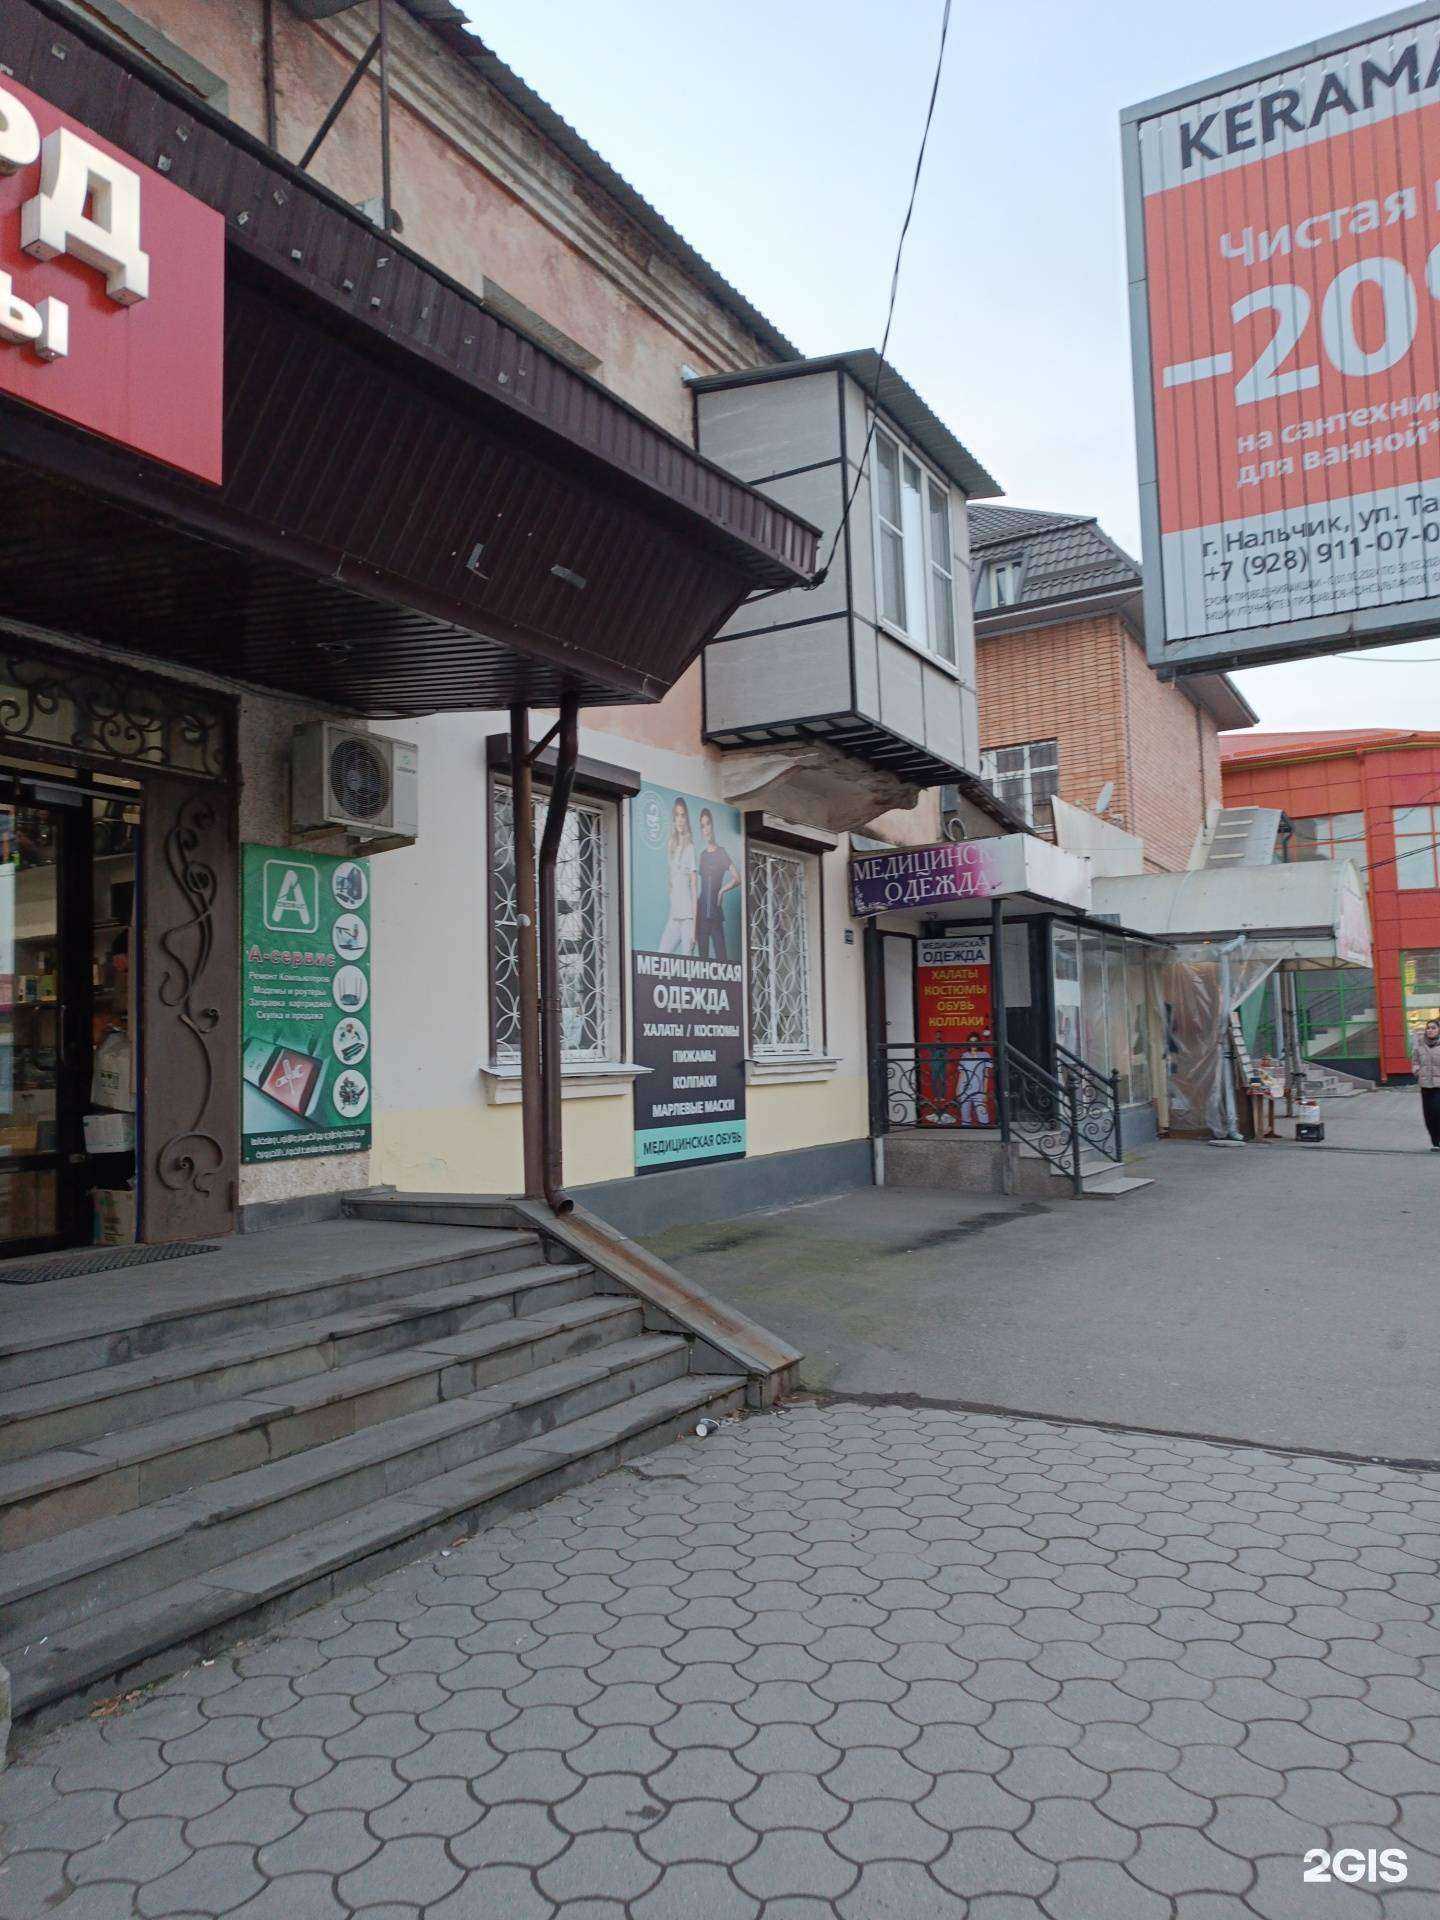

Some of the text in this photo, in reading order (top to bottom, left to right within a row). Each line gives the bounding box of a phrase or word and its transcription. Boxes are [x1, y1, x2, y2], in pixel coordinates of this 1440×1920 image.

[1220, 186, 1417, 266] Чистая
[1237, 431, 1273, 455] на
[1236, 463, 1294, 488] для
[1202, 541, 1218, 558] г.
[1226, 513, 1350, 553] Нальчик,
[1358, 505, 1399, 532] ул.
[1204, 561, 1233, 582] +7
[1243, 549, 1307, 583] (928)
[884, 869, 991, 903] ОДЕЖДА
[923, 949, 985, 963] ОДЕЖДА
[637, 954, 741, 983] МЕДИЦИНСКАЯ
[931, 968, 979, 980] ХАЛАТЫ
[653, 984, 730, 1014] ОДЕЖДА
[924, 985, 987, 996] КОСТЮМЫ
[936, 1000, 975, 1012] ОБУВЬ
[643, 1023, 684, 1037] ХАЛАТЫ
[694, 1025, 740, 1037] КОСТЮМЫ
[928, 1016, 984, 1028] КОЛПАКИ
[672, 1049, 717, 1063] ПИЖАМЫ
[672, 1075, 717, 1089] КОЛПАКИ
[652, 1098, 735, 1118] МАРЛЕВЫЕ МАСКИ
[643, 1131, 742, 1155] МЕДИЦИНСКАЯ ОБУВЬ
